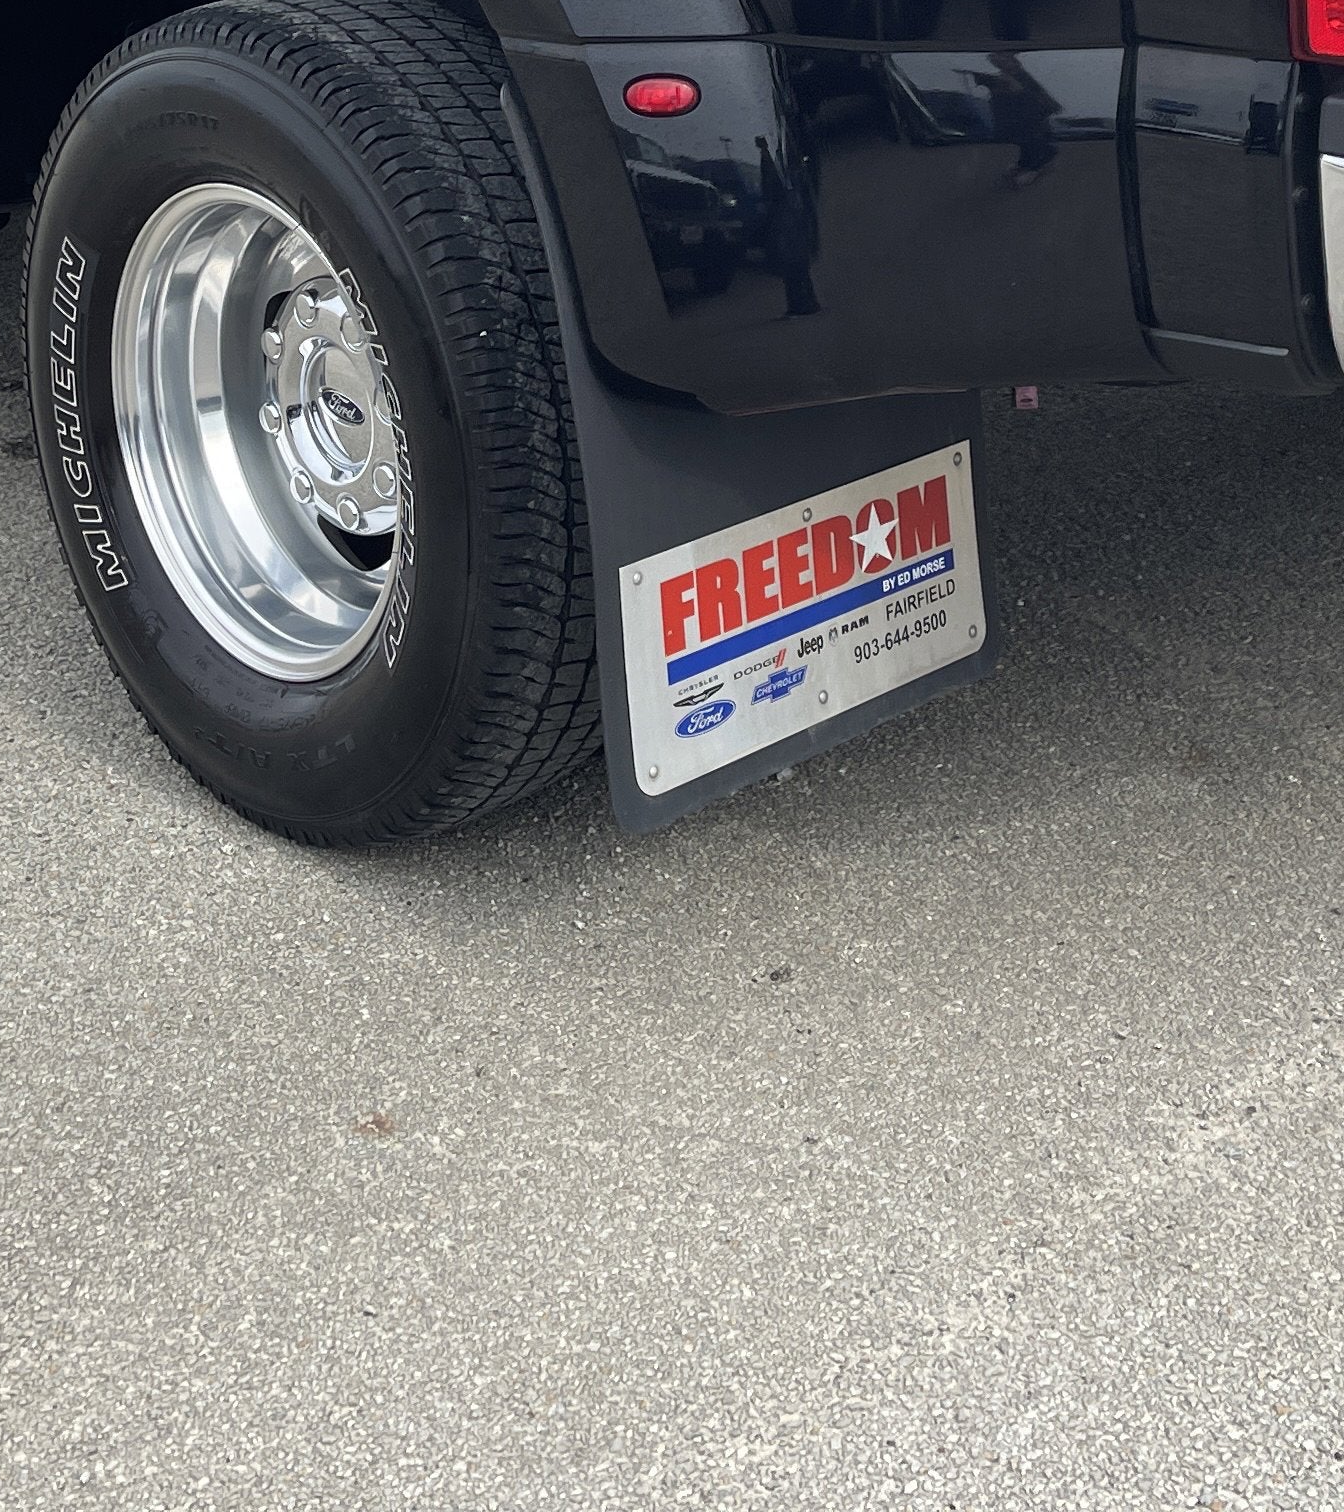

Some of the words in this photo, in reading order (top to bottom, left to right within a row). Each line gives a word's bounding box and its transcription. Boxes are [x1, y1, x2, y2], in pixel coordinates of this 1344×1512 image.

[50, 236, 129, 592] MICHELIN
[328, 393, 357, 420] Ford
[339, 268, 416, 669] MICHELIN
[659, 474, 952, 657] FREEDOM
[882, 577, 896, 593] BY
[897, 571, 911, 587] ED
[912, 556, 946, 581] MORSE
[885, 578, 956, 622] FAIRFIELD
[841, 615, 870, 635] RAM
[853, 609, 947, 664] 903-644-9500
[797, 635, 824, 659] Jeep
[678, 674, 719, 696] CHRYSLER
[756, 670, 804, 698] CHEVROLET
[687, 705, 726, 734] Ford
